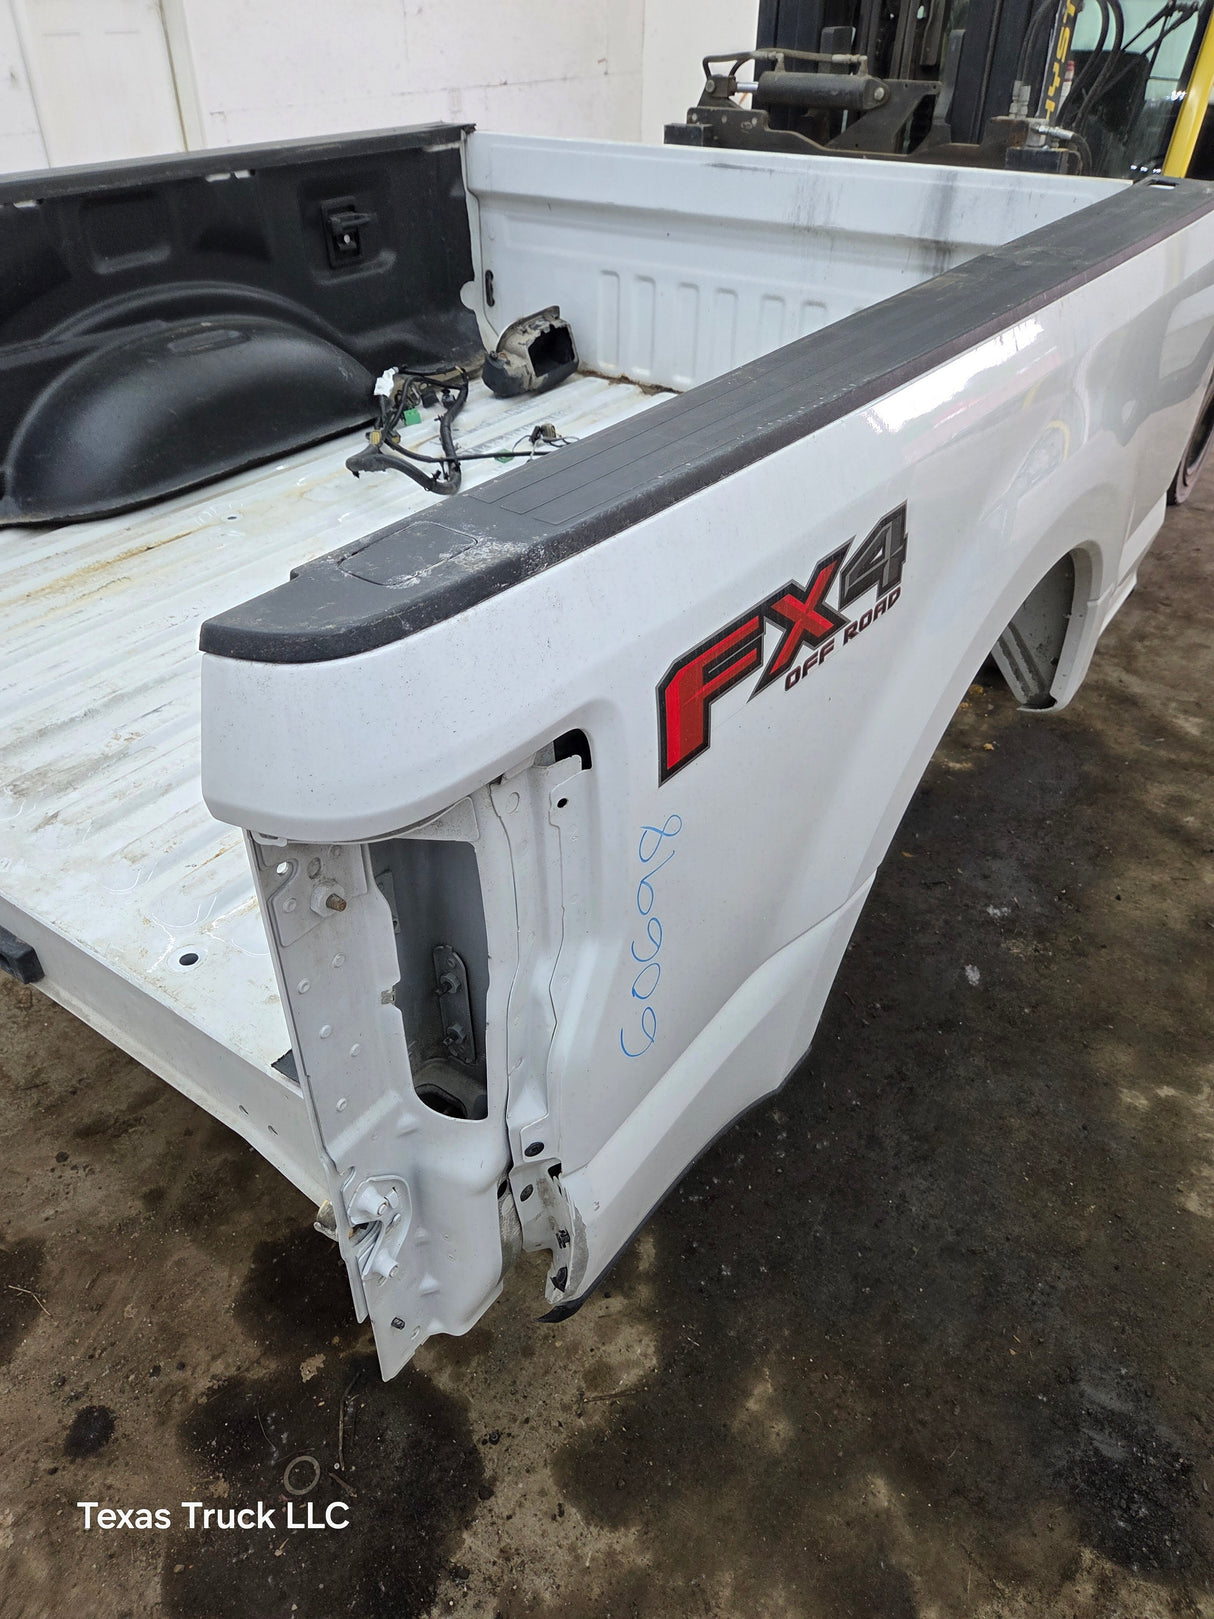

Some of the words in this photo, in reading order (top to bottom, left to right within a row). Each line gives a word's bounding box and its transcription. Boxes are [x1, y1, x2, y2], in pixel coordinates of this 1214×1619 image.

[656, 498, 908, 788] FX4
[784, 639, 835, 691] OFF
[843, 587, 901, 646] ROAD
[620, 814, 682, 1057] 60698
